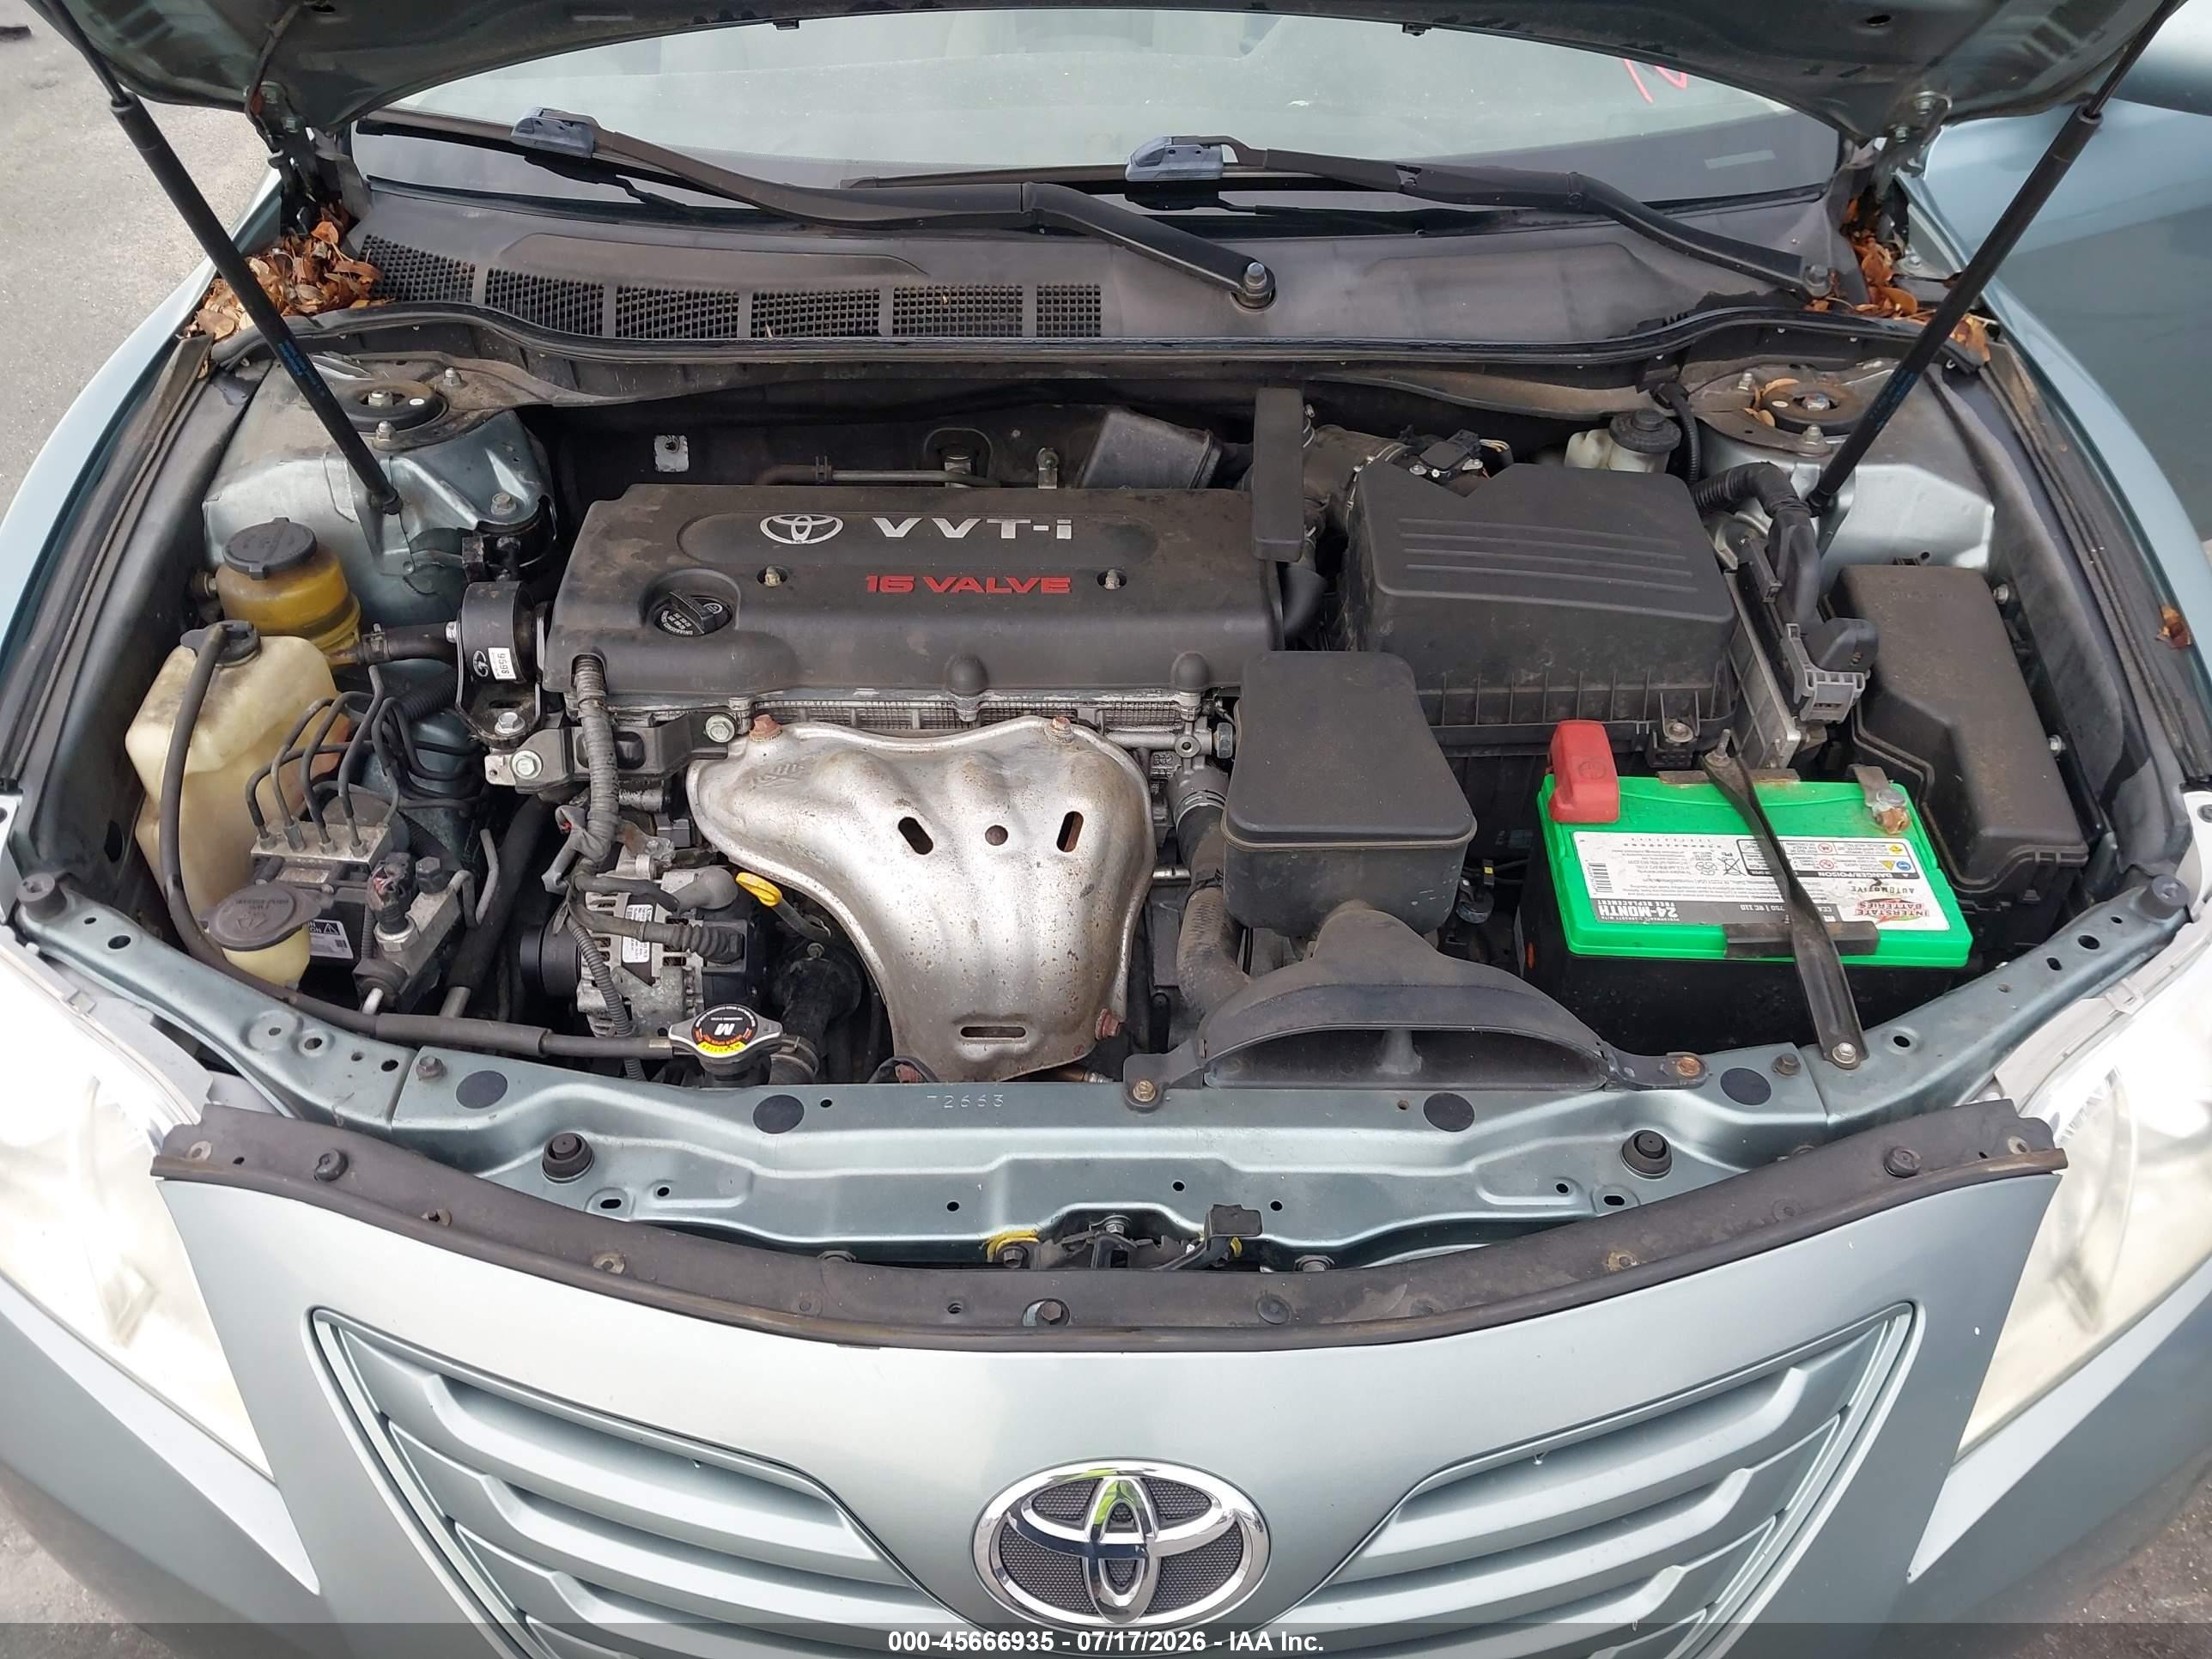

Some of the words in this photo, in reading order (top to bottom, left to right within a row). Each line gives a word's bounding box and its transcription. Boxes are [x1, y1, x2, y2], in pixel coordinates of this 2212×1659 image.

[872, 517, 1073, 539] VVT-i
[866, 574, 915, 592] 16
[922, 576, 1072, 593] VALVE
[1817, 871, 1893, 879] DANGER/POISON
[1598, 905, 1679, 918] 24-MONTH
[1858, 902, 1923, 910] BATTERIES
[1856, 908, 1929, 917] INTERSTATE
